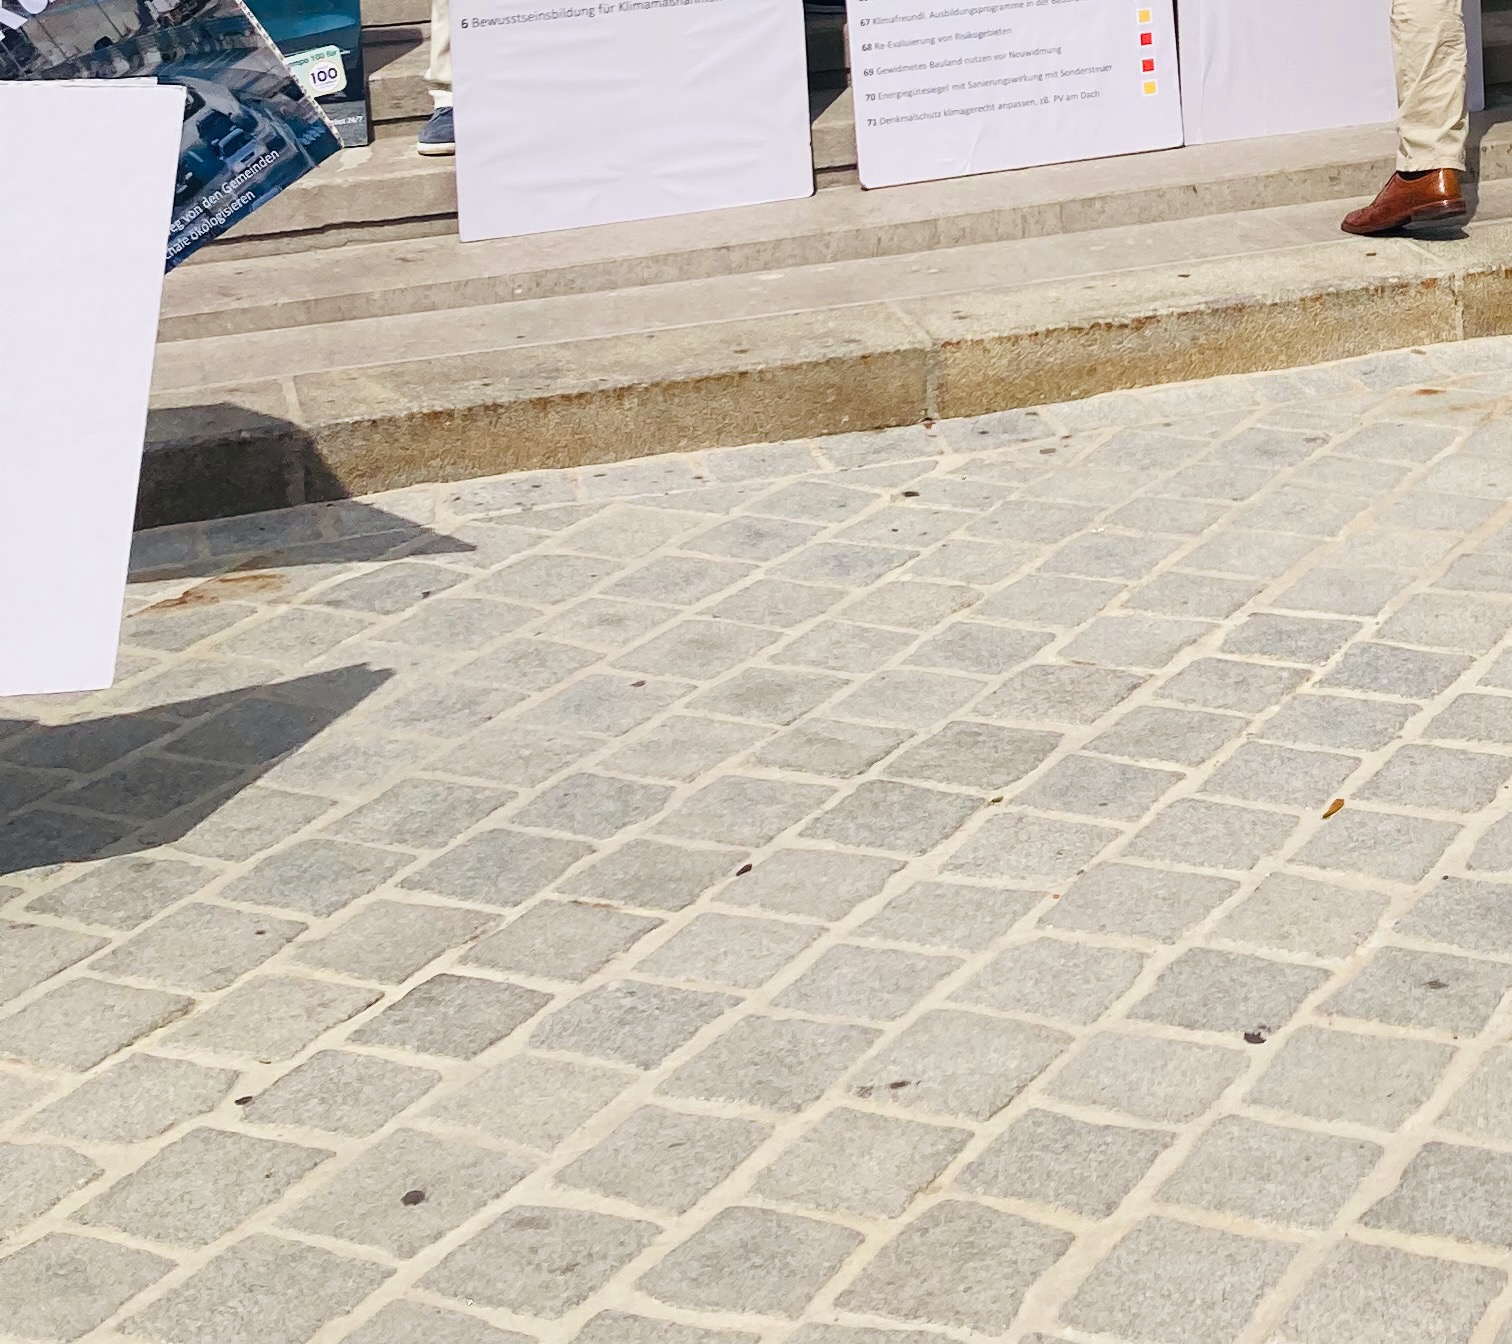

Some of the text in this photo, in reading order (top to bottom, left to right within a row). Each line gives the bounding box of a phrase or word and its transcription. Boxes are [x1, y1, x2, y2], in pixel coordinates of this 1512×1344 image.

[460, 18, 469, 29] 6
[472, 7, 595, 27] Bewusstseinsbildung
[863, 68, 874, 76] 69
[876, 63, 927, 75] Gewidmetes
[929, 57, 962, 68] Bauland
[1008, 46, 1061, 58] Neuwidmung
[311, 67, 338, 84] 100
[168, 150, 280, 234] eg von den Gemeinden
